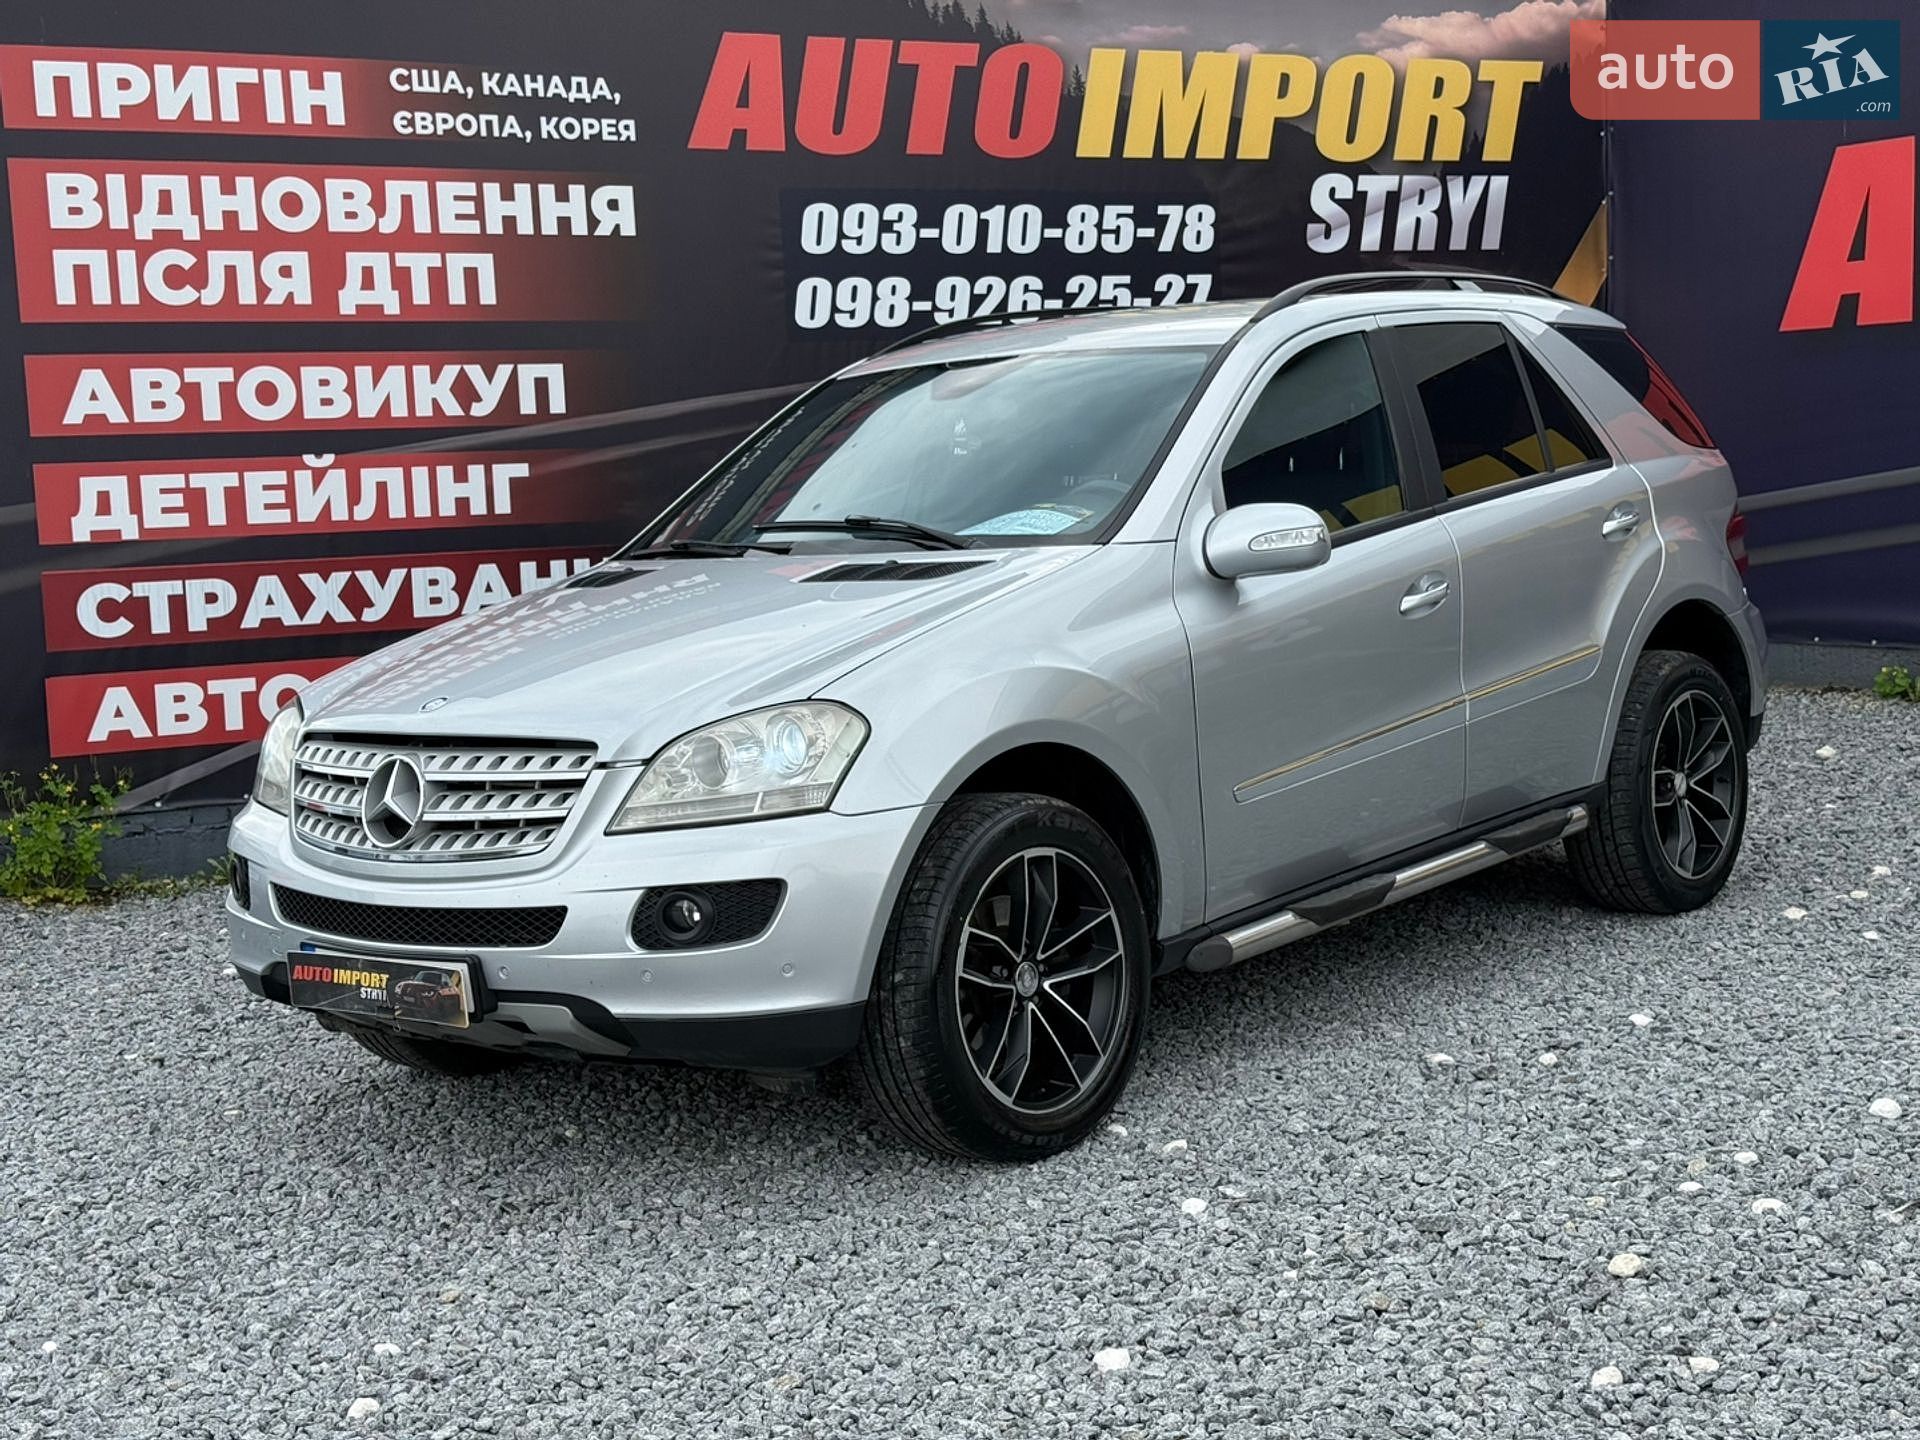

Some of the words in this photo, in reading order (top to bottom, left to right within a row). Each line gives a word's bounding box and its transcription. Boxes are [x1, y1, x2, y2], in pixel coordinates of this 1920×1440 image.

[31, 60, 346, 126] ПРИГІН
[389, 67, 474, 99] США,
[481, 71, 622, 104] КАНАДА,
[393, 110, 533, 142] ЄВРОПА,
[539, 116, 637, 142] КОРЕЯ
[45, 172, 637, 240] ВІДНОВЛЕННЯ
[800, 202, 1216, 255] 093-010-85-78
[1306, 173, 1509, 254] STRYI
[52, 249, 313, 306] ПІСЛЯ
[337, 251, 497, 315] ДТП
[794, 274, 1213, 329] 098-926-25-27
[62, 363, 567, 425] АВТОВИКУП
[70, 453, 530, 543] ДЕТЕЙЛІНГ
[292, 965, 332, 983] AUTO
[333, 968, 389, 988] IMPORT
